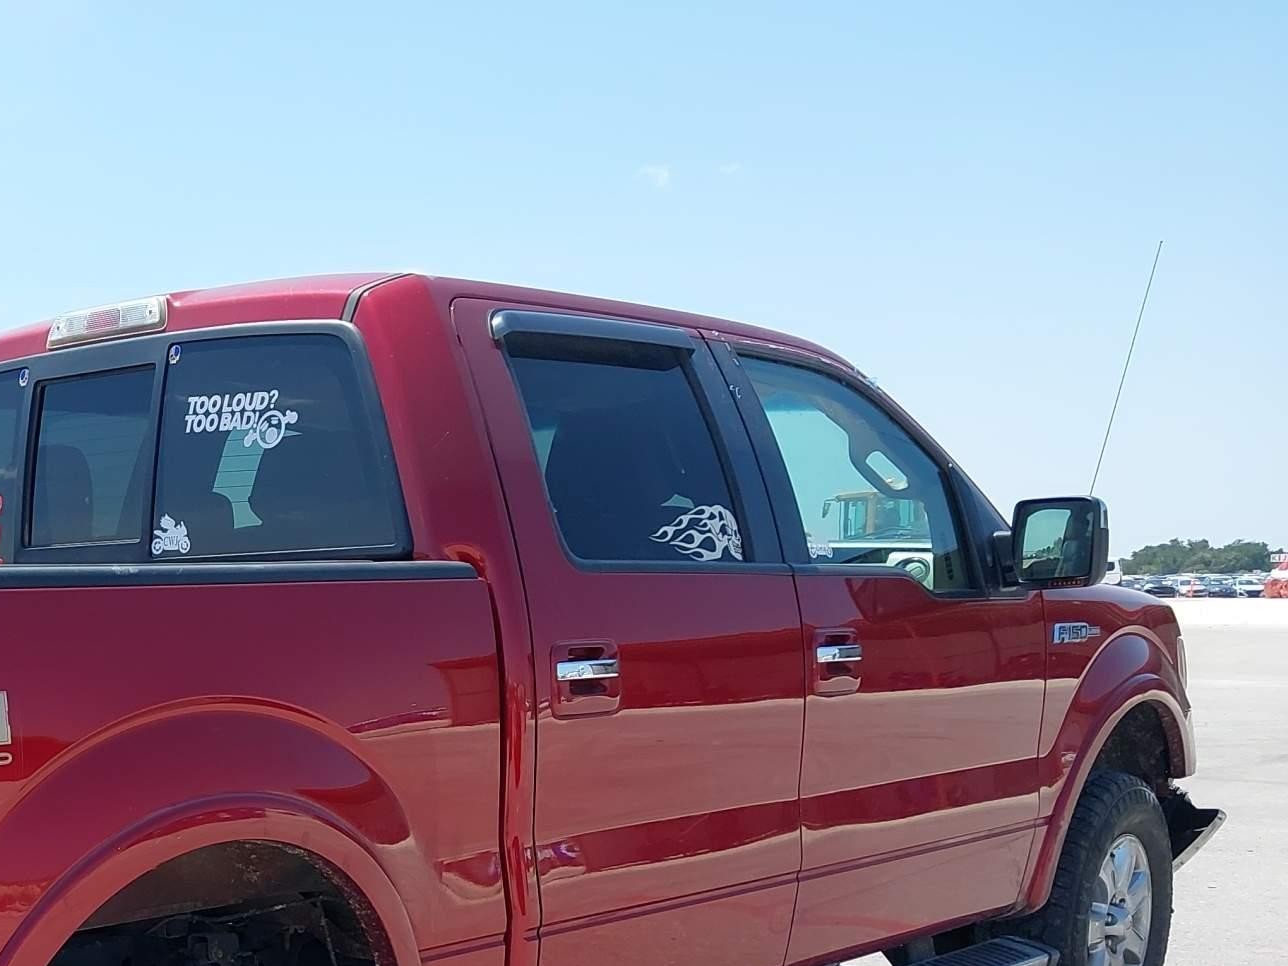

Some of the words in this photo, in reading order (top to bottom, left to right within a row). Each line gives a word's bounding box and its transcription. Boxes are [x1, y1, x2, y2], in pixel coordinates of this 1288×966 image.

[188, 395, 221, 414] TOO
[222, 390, 279, 412] LOUD?
[185, 413, 218, 433] TOO
[219, 411, 259, 431] BAD!
